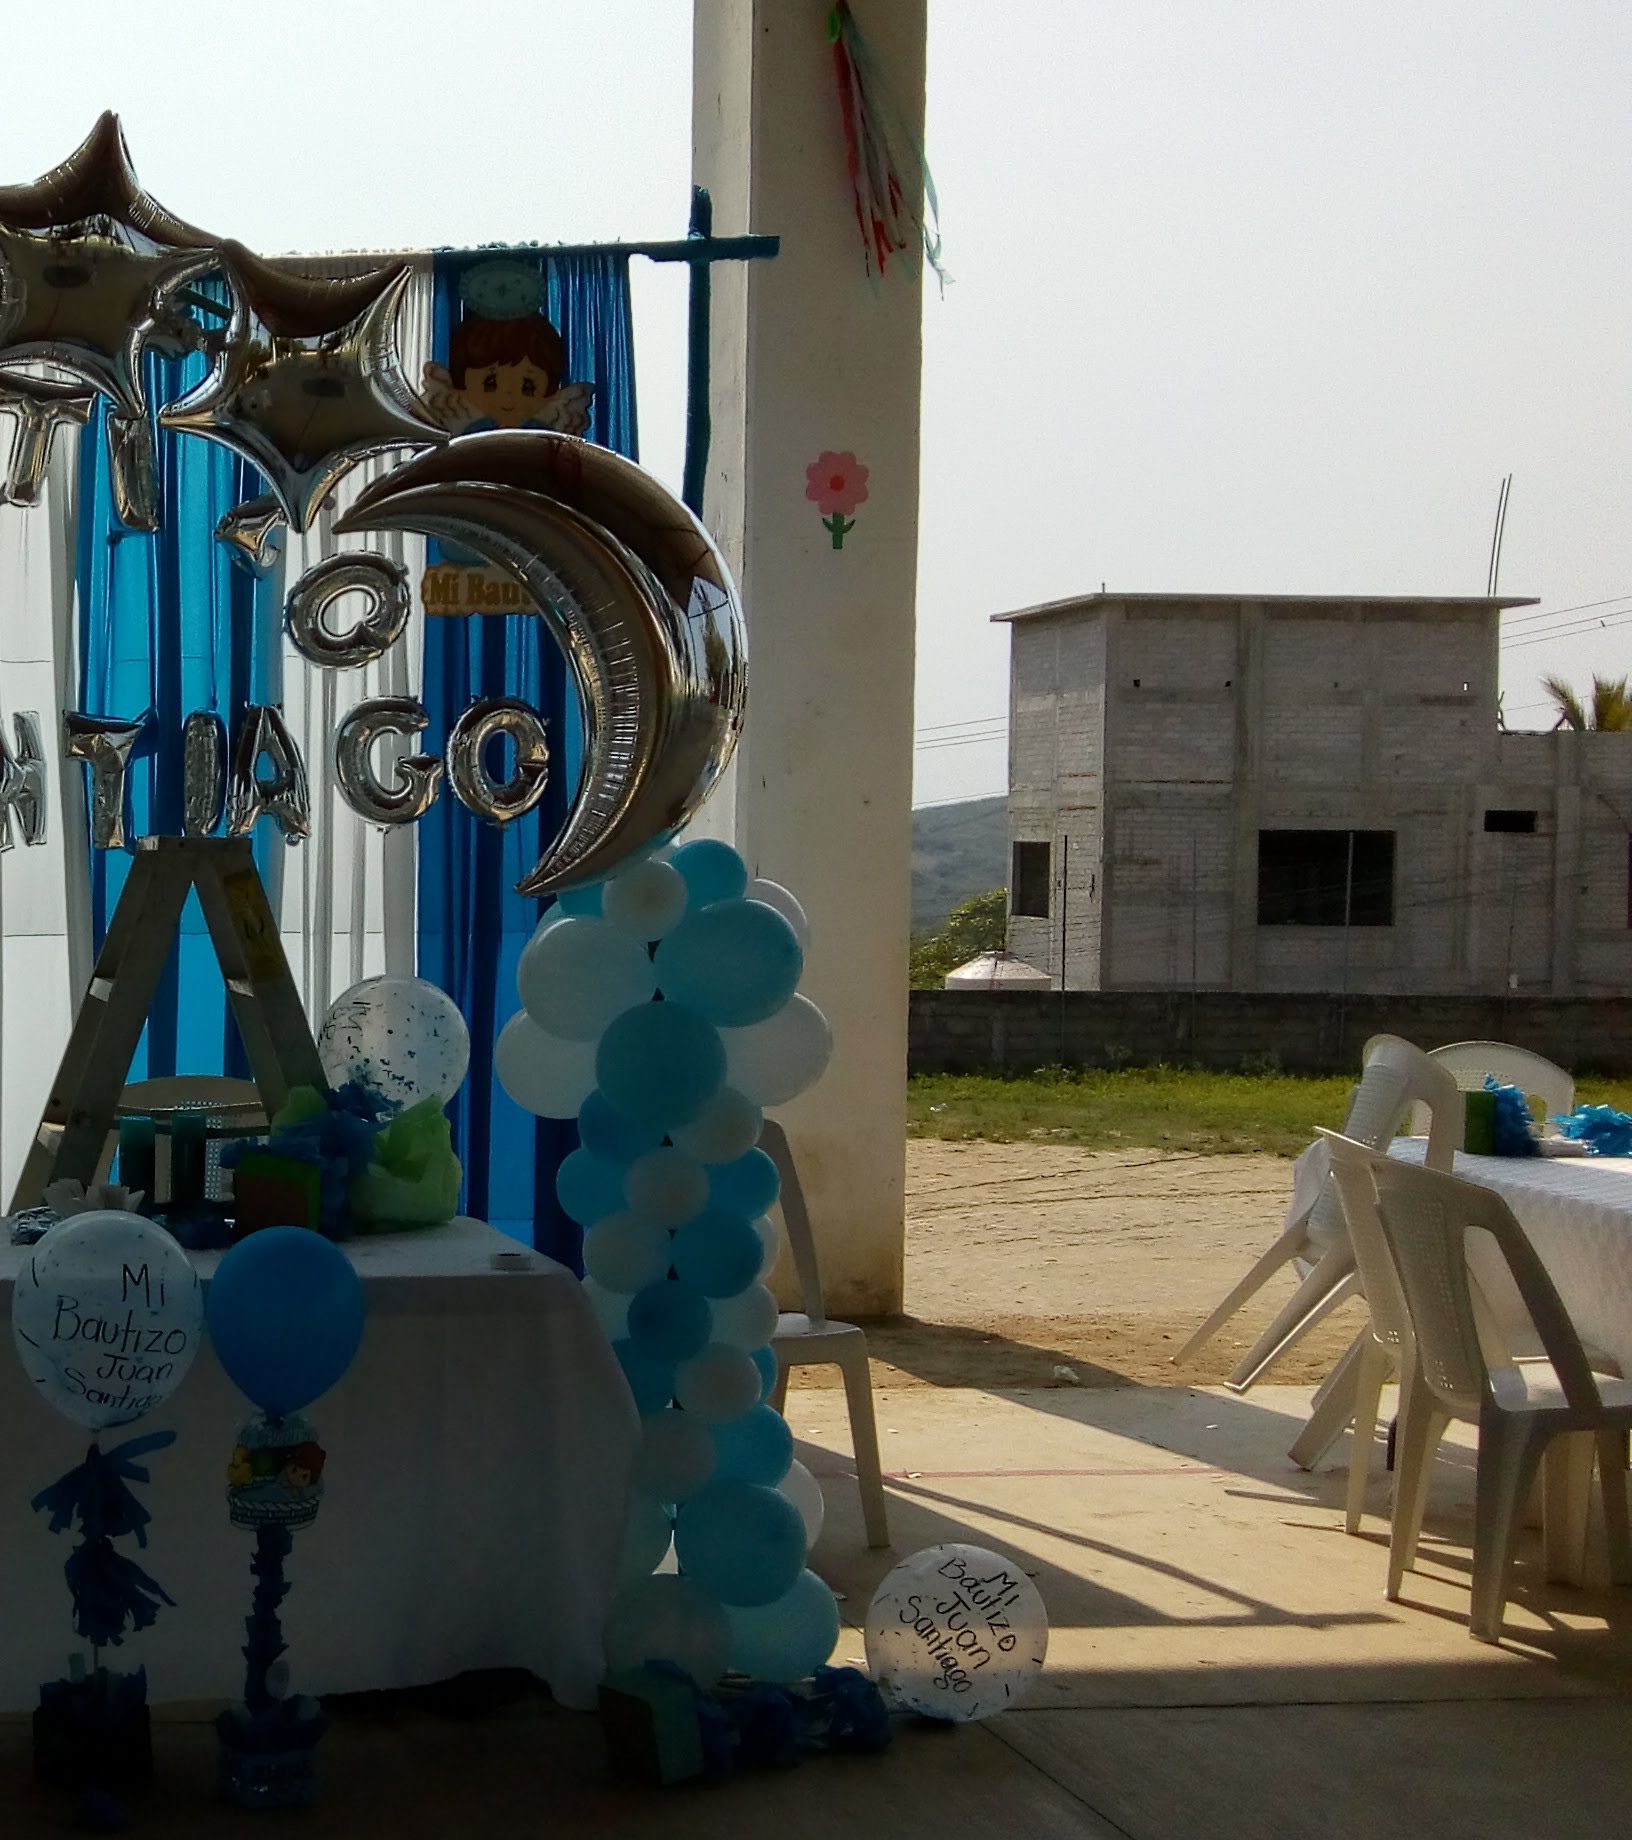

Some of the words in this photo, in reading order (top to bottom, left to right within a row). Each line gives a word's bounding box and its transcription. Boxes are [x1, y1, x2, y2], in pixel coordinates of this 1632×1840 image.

[428, 571, 459, 605] Mi
[52, 1294, 187, 1355] Bautizo
[96, 1353, 173, 1384] Juan
[899, 1595, 973, 1693] Santiago
[935, 1590, 991, 1670] Juan
